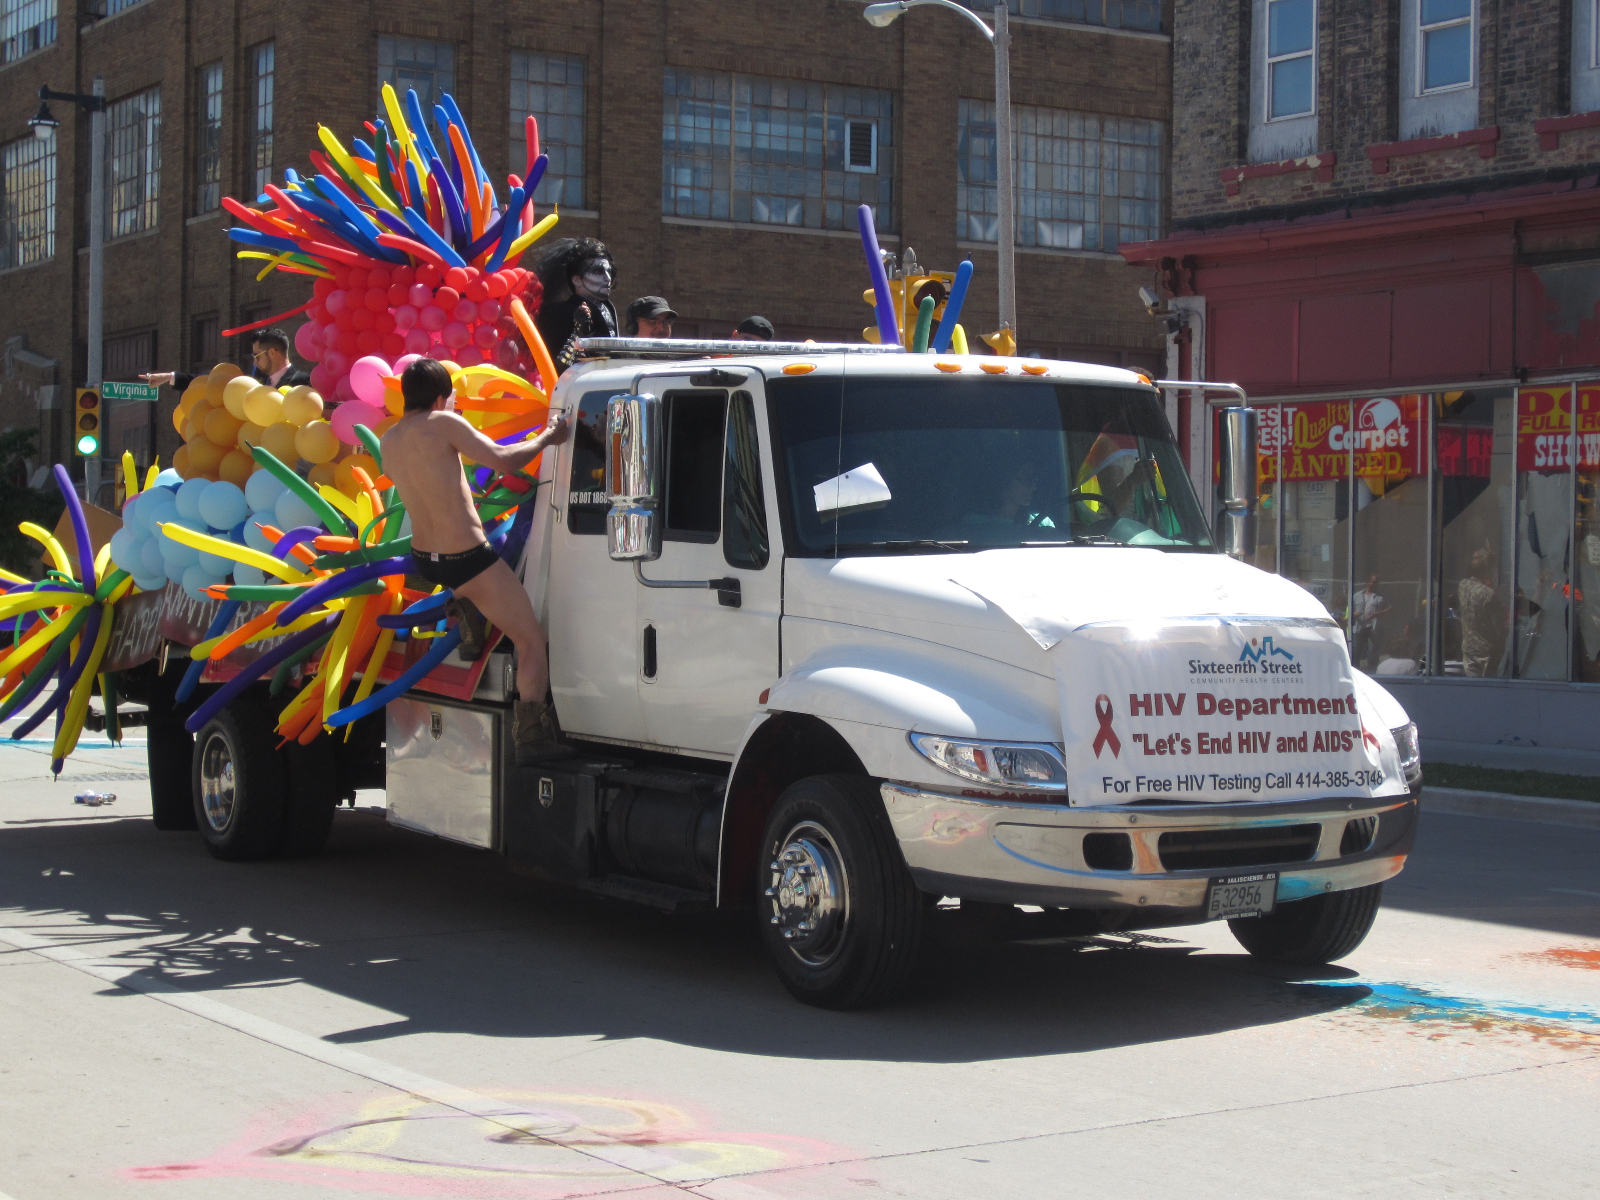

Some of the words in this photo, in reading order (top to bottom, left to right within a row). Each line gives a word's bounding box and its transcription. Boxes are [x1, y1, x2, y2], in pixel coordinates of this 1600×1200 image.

[113, 383, 148, 398] Virginia
[1291, 403, 1354, 453] Quality
[1518, 413, 1572, 432] FULL
[1581, 413, 1600, 430] R
[1328, 424, 1409, 451] Carpet
[570, 492, 578, 504] US
[579, 492, 592, 504] DOT
[1189, 659, 1257, 675] Sixteenth
[1260, 659, 1303, 674] Street
[1190, 677, 1236, 685] COMMUNITY
[1129, 692, 1187, 717] HIV
[1196, 692, 1358, 721] Department
[1132, 732, 1192, 756] "Let's
[1197, 731, 1233, 755] End
[1237, 731, 1271, 754] HIV
[1276, 730, 1308, 753] and
[1312, 730, 1362, 753] AIDS"
[1102, 776, 1131, 794] For
[1135, 775, 1173, 793] Free
[1176, 774, 1205, 792] HIV
[1208, 773, 1262, 794] Testing
[1265, 772, 1292, 789] Call
[1295, 770, 1383, 789] 414-385-3748
[1223, 886, 1261, 907] 32956
